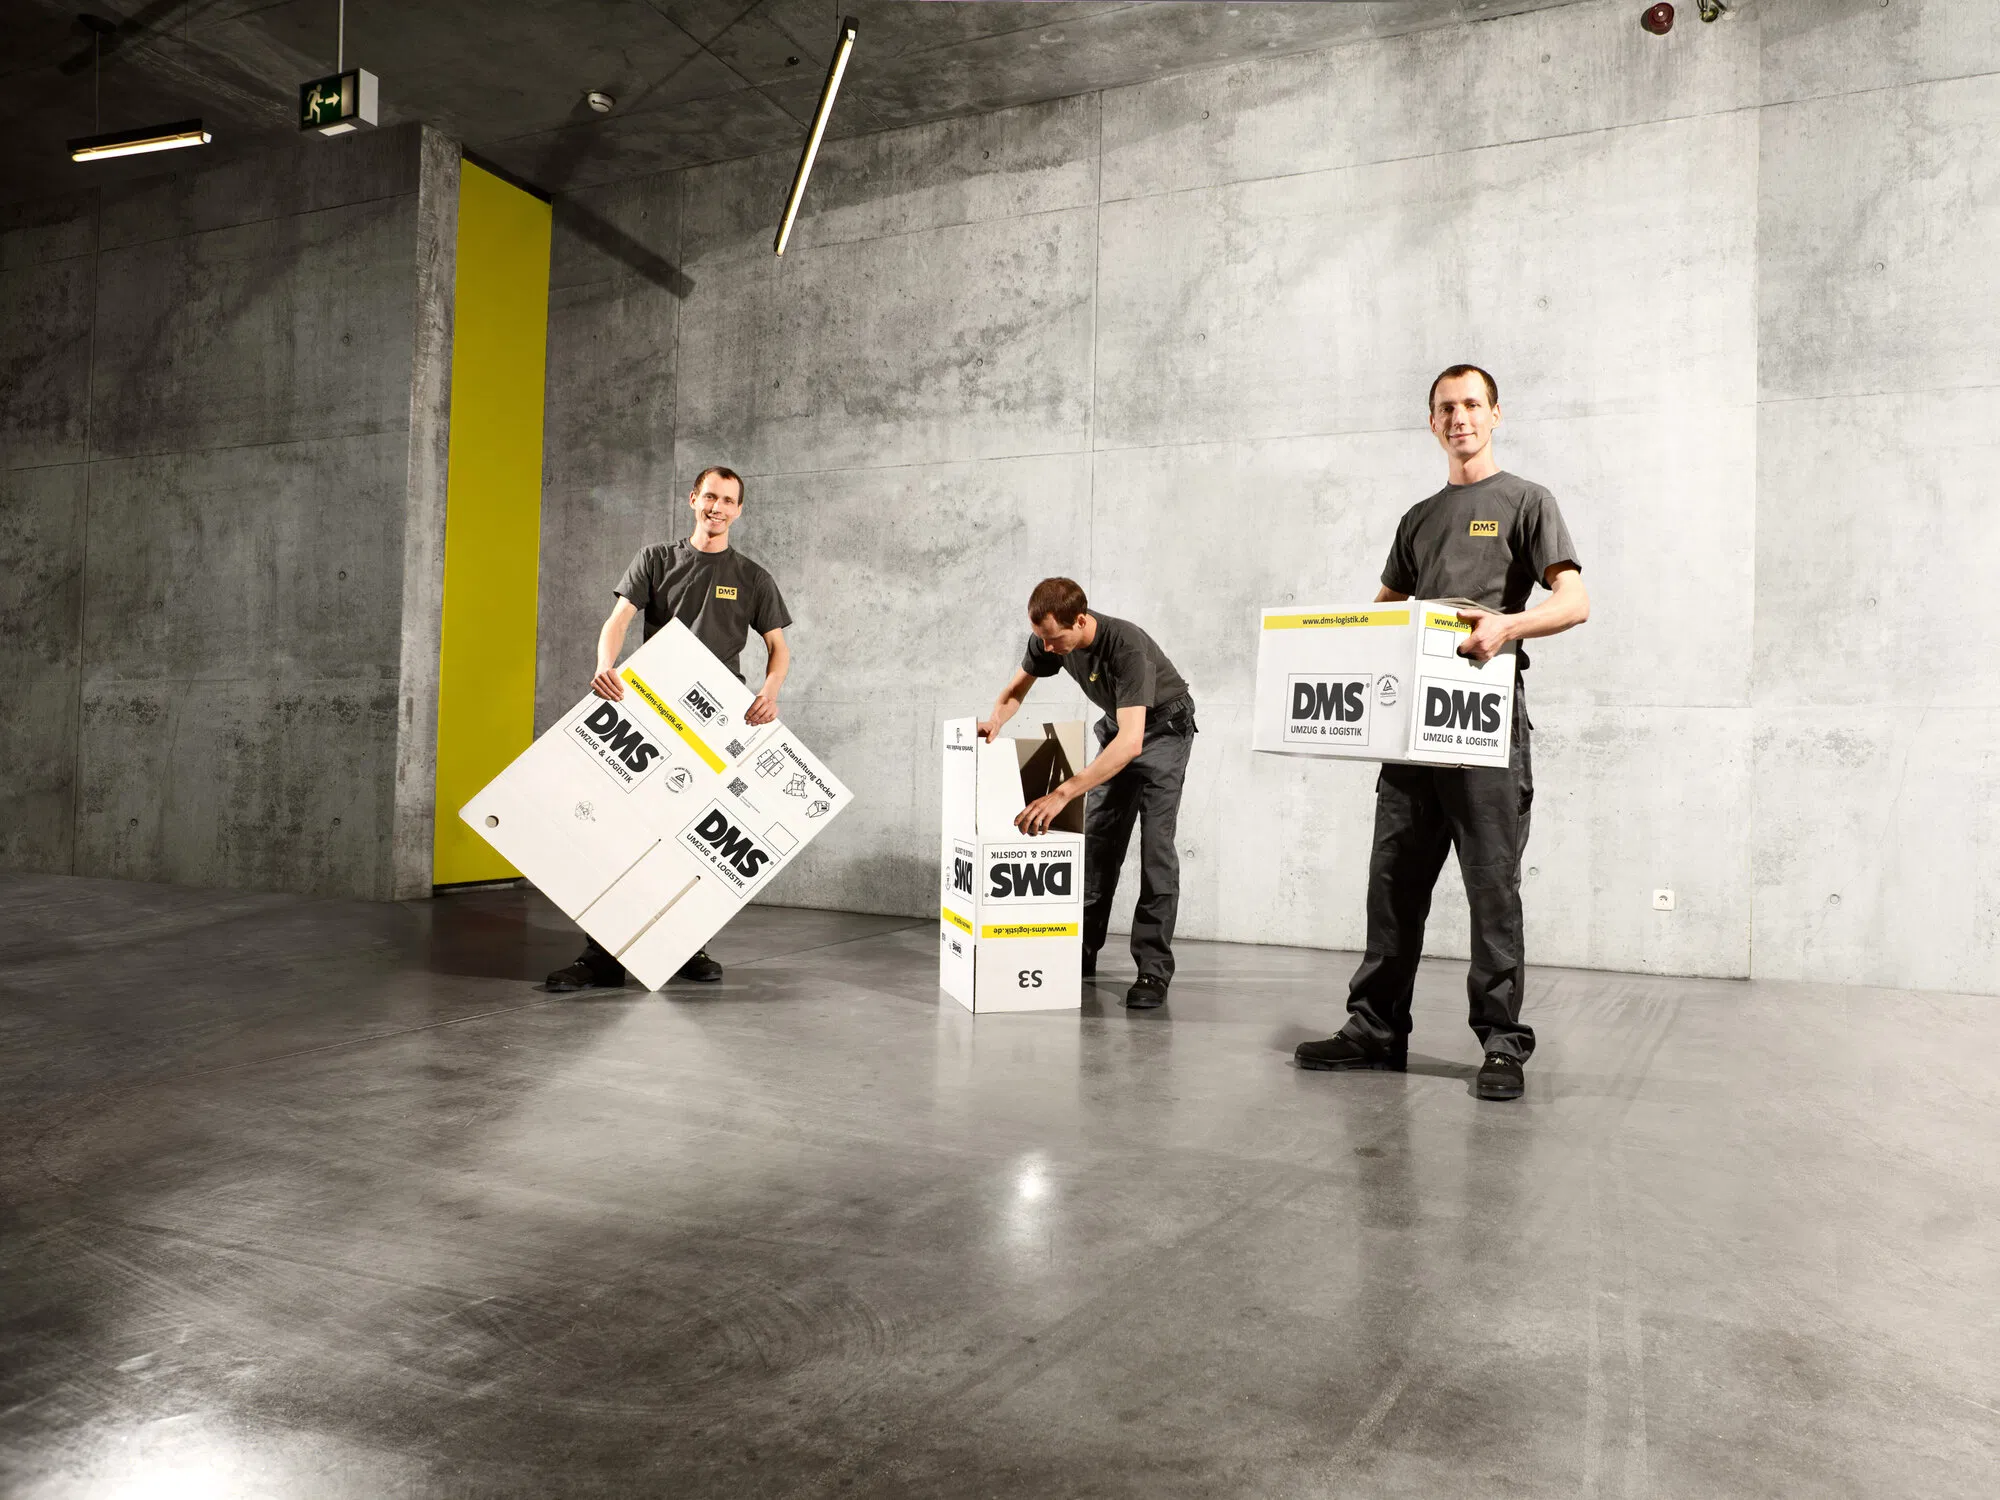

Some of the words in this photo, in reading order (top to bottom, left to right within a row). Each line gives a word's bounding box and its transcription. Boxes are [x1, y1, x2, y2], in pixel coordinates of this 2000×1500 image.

[1472, 523, 1496, 532] DMS
[718, 588, 736, 596] DMS
[1302, 615, 1369, 626] www.dms-logistik.de
[1434, 618, 1472, 629] www.dms-
[631, 678, 684, 732] www.dms-logistik.de
[686, 688, 716, 719] DMS
[1291, 681, 1365, 723] DMS
[1424, 686, 1501, 733] DMS
[583, 700, 660, 773] DMS
[1290, 725, 1318, 735] UMZUG
[1320, 726, 1327, 735] &
[1329, 726, 1362, 737] LOGISTIK
[1423, 732, 1453, 743] UMZUG
[1456, 735, 1463, 744] &
[1465, 736, 1499, 748] LOGISTIK
[575, 725, 600, 751] UMZUG
[598, 749, 606, 757] &
[605, 755, 634, 784] LOGISTIK
[780, 742, 817, 782] Faltanleitung
[815, 778, 836, 800] Deckel
[694, 808, 770, 878] DMS
[991, 851, 1027, 859] LOGISTIK
[1030, 850, 1037, 858] &
[1040, 850, 1072, 858] UMZUG
[686, 833, 711, 857] UMZUG
[710, 855, 718, 864] &
[717, 861, 746, 889] LOGISTIK
[954, 857, 973, 895] DMS
[990, 862, 1072, 898] DMS
[993, 926, 1067, 935] www.dms-logistik.de
[1018, 969, 1043, 988] S3
